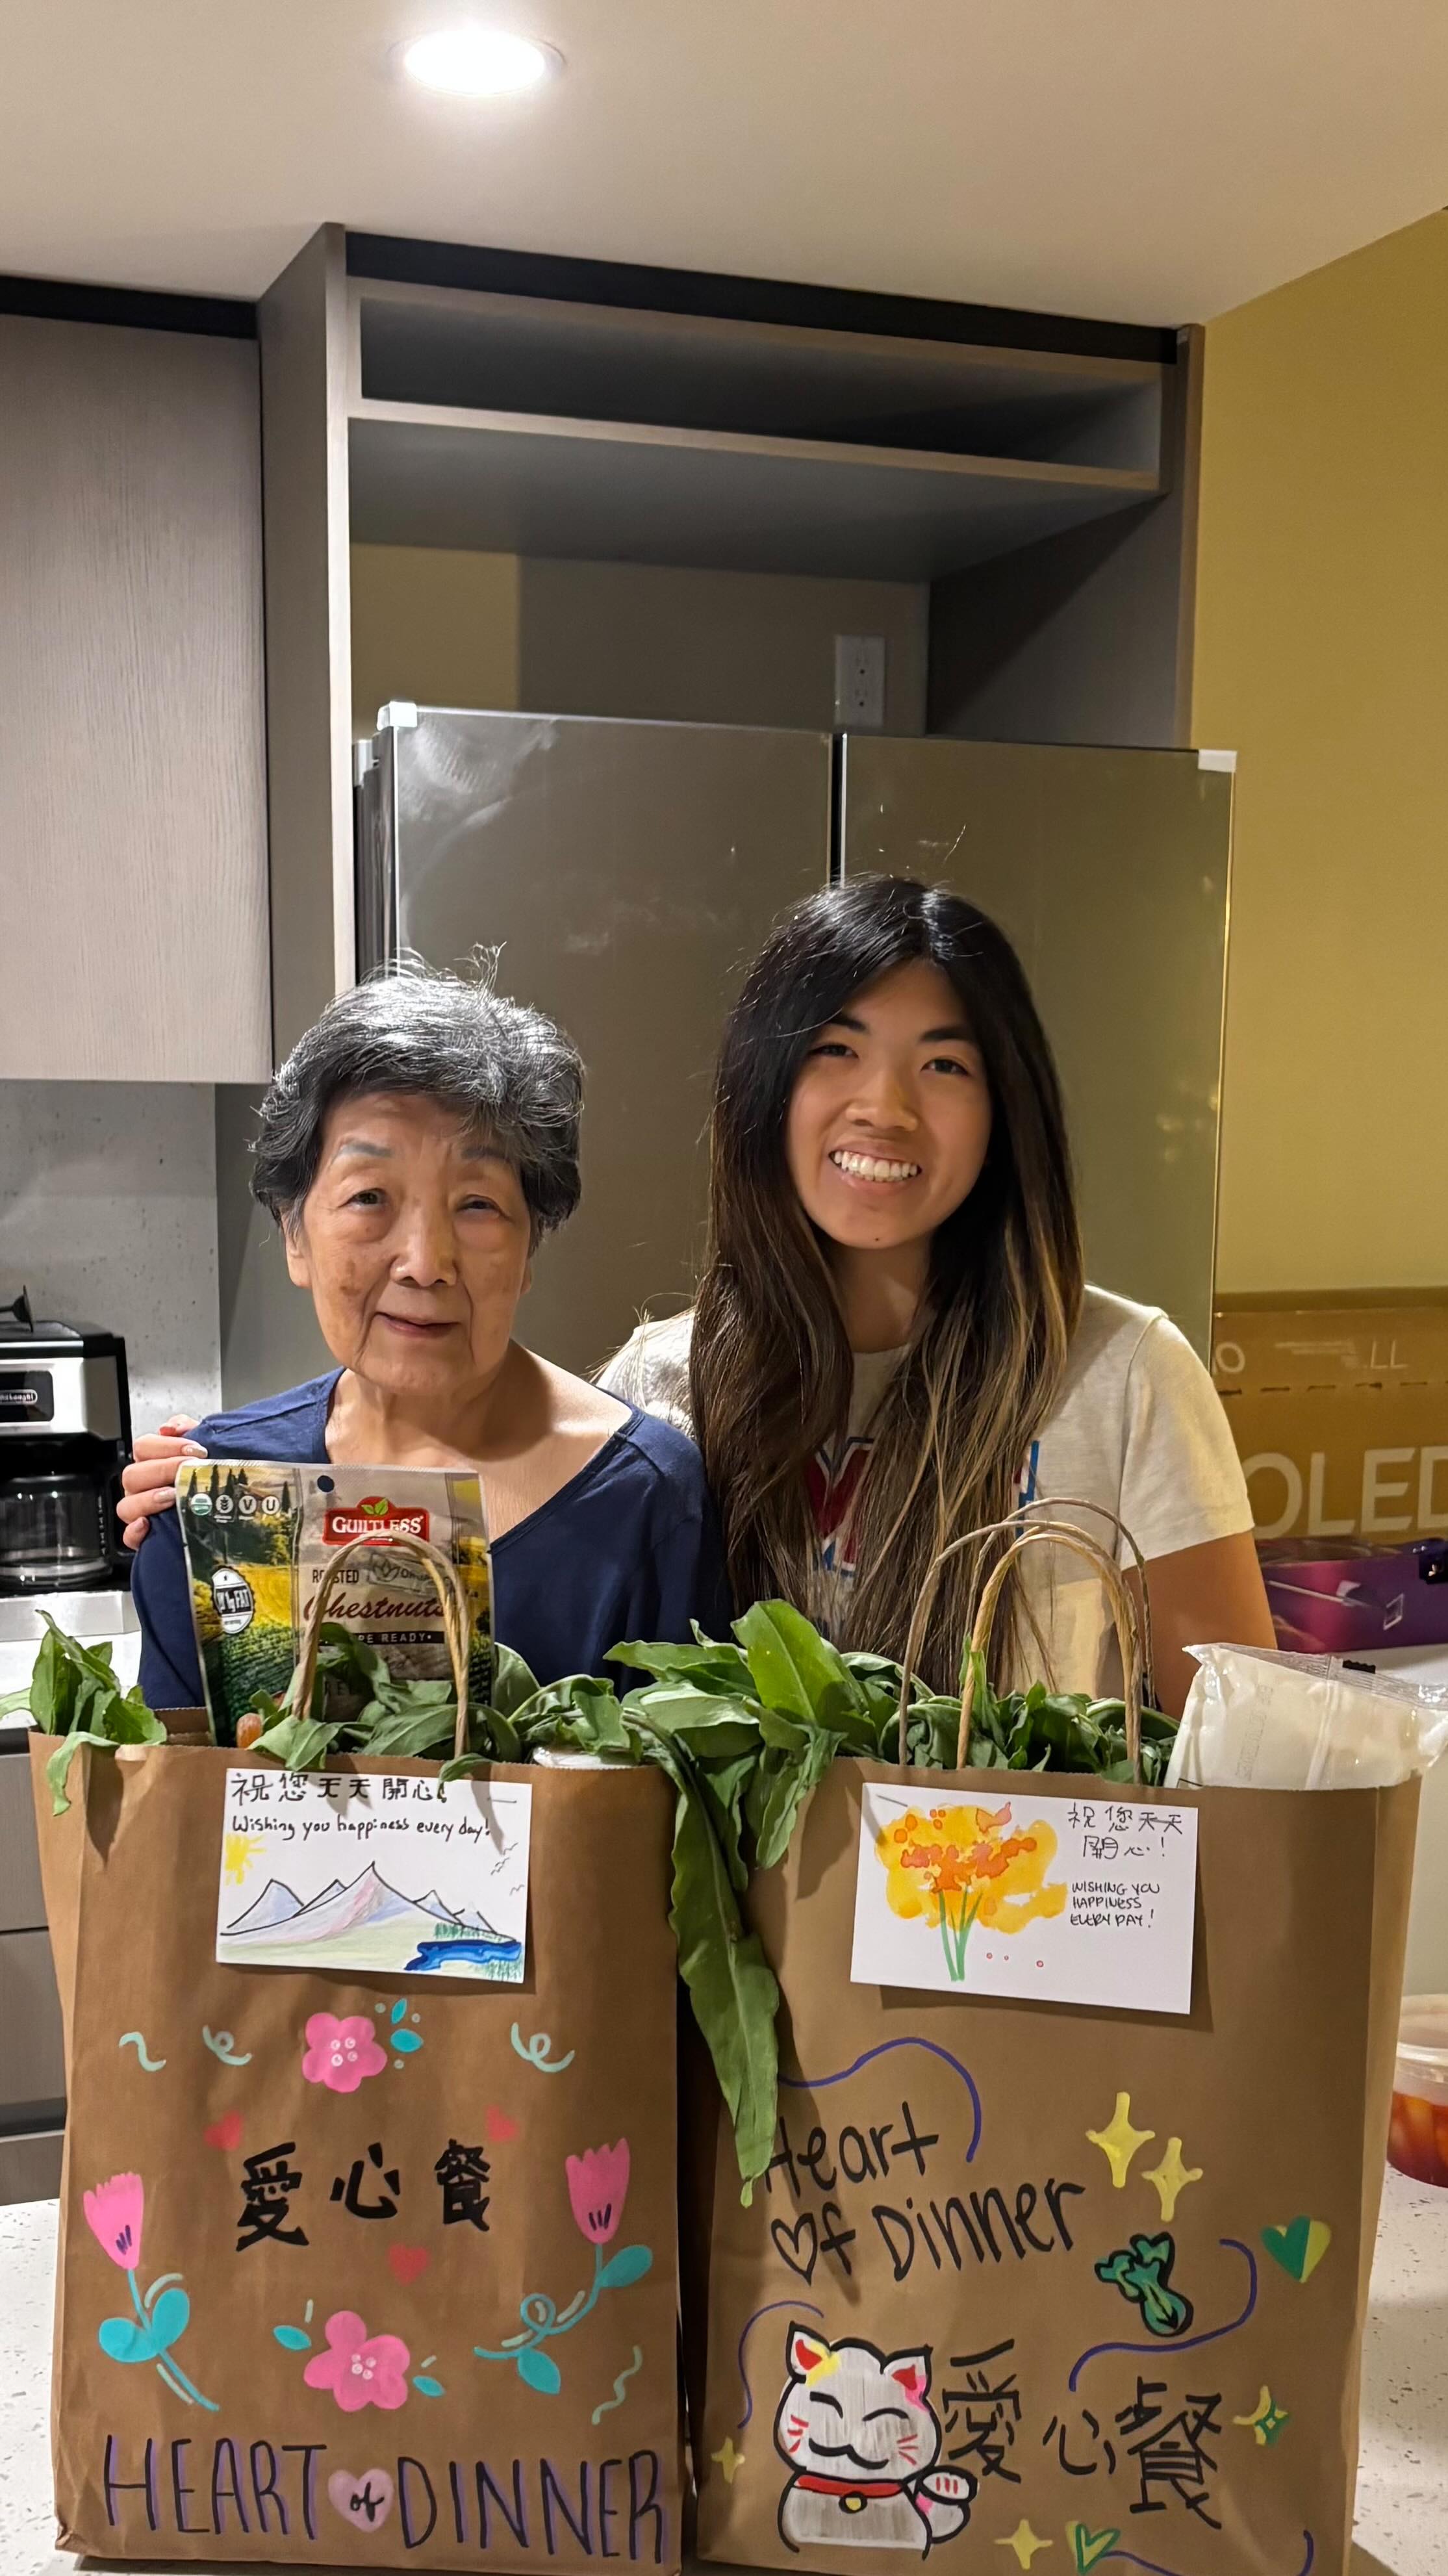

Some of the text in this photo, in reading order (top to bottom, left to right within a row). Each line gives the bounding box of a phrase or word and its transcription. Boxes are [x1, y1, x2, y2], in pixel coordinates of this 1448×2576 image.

[332, 1516, 422, 1534] GUILTLESS
[312, 1569, 359, 1583] RSTED
[233, 1813, 490, 1843] Wishing you happiness every day!
[1072, 1881, 1160, 1896] WISHING YOU
[764, 2100, 939, 2199] Heart
[871, 2178, 1086, 2282] Dinner
[103, 2434, 669, 2566] HEART of DINNER
